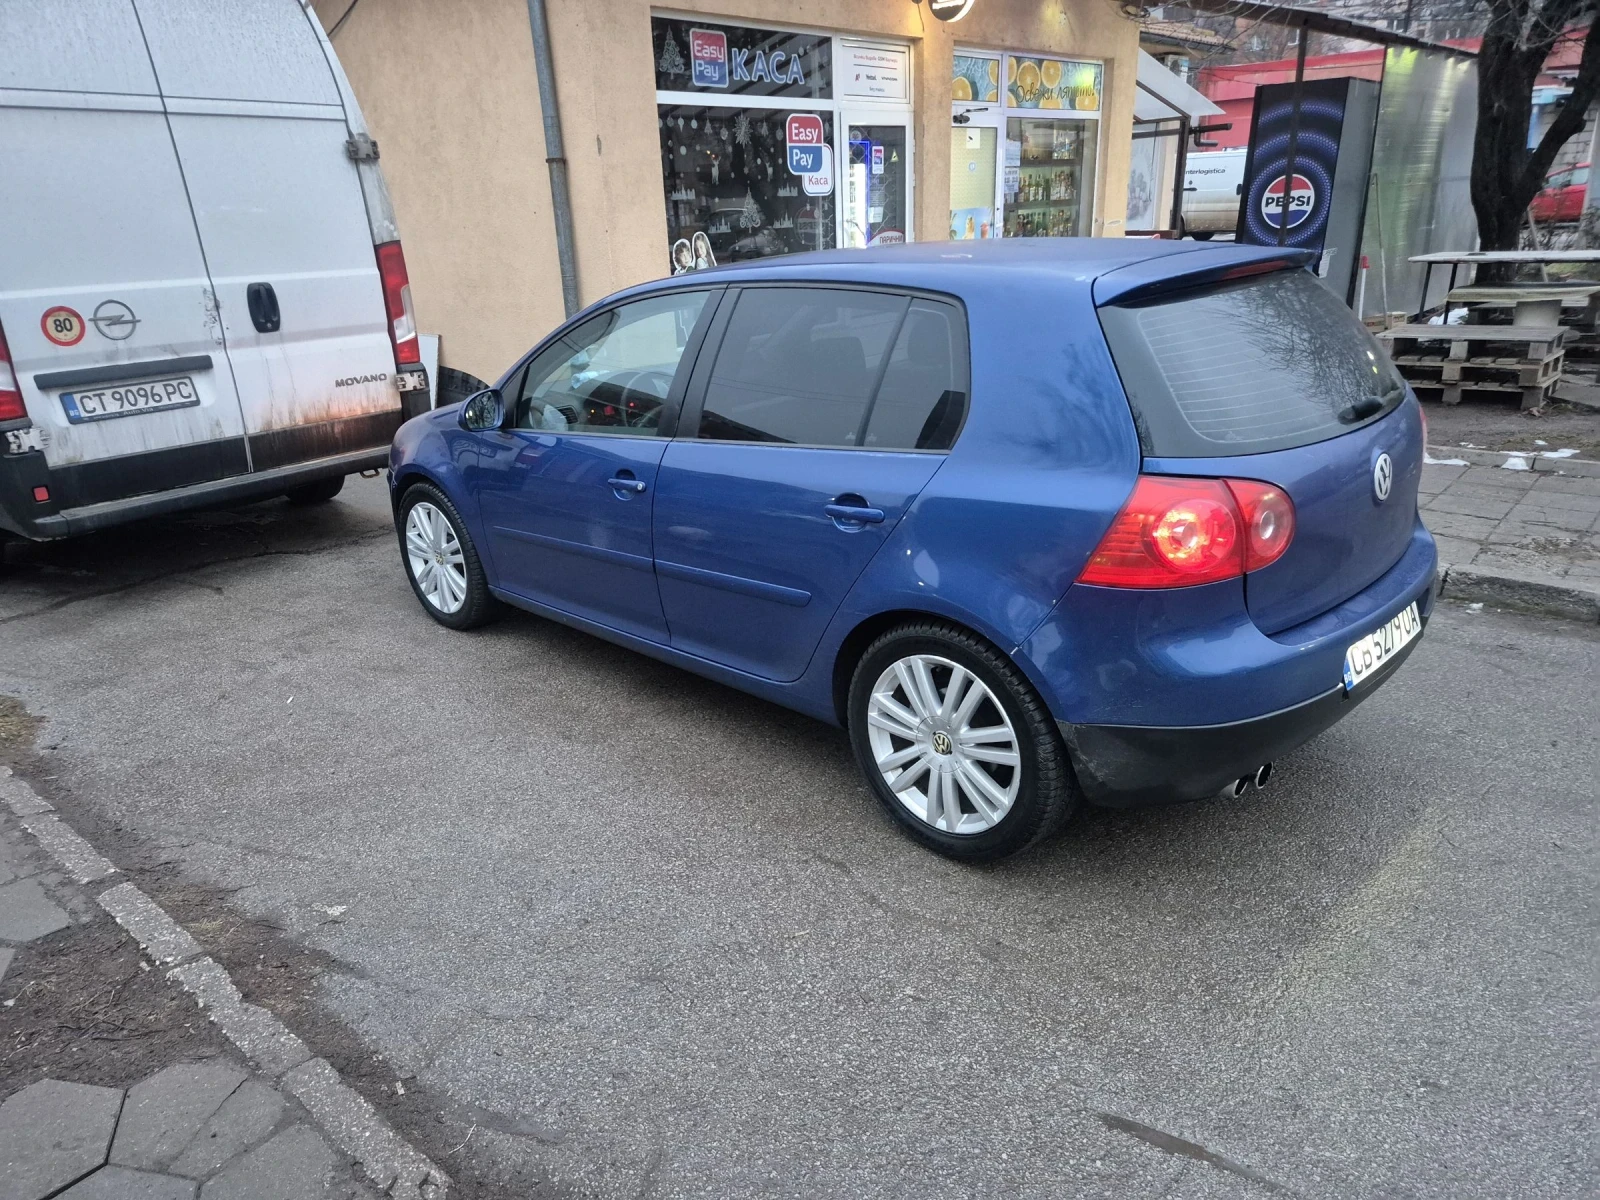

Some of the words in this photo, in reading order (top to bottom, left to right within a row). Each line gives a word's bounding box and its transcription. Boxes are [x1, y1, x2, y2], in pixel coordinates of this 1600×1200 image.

[693, 40, 724, 62] Easy
[695, 60, 719, 80] Pay
[731, 48, 805, 84] КАСА
[792, 123, 818, 143] Easy
[792, 148, 813, 169] Pay
[808, 175, 829, 186] Каса
[1185, 168, 1225, 176] nterlogistica
[1265, 195, 1311, 207] PEPSI
[53, 317, 73, 333] 80
[335, 373, 387, 388] MOVANO
